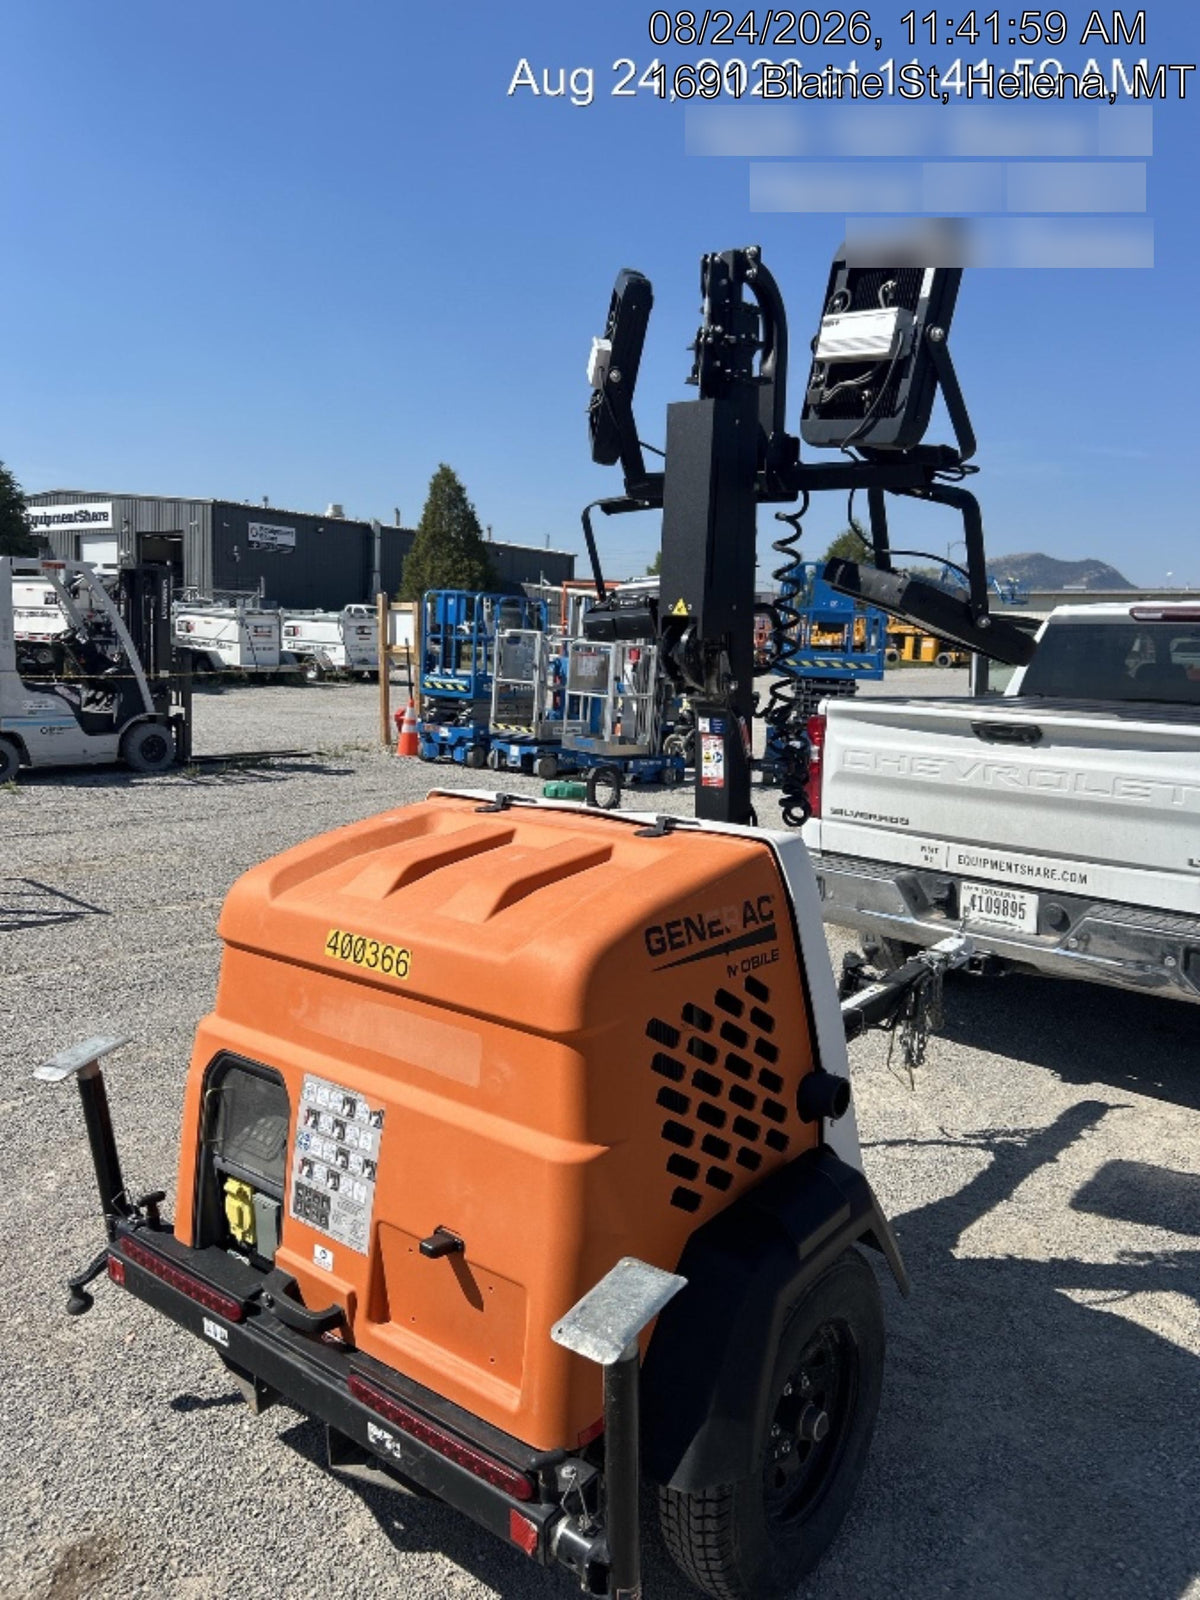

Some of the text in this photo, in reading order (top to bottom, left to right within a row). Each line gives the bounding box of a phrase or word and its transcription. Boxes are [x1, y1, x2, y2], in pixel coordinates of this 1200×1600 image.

[842, 747, 1200, 805] CHEVROLET
[957, 854, 1088, 885] EQUIPMENTSHARE.COM
[644, 895, 775, 957] GENEAC
[969, 893, 1026, 921] 4109895
[327, 930, 411, 977] 400366
